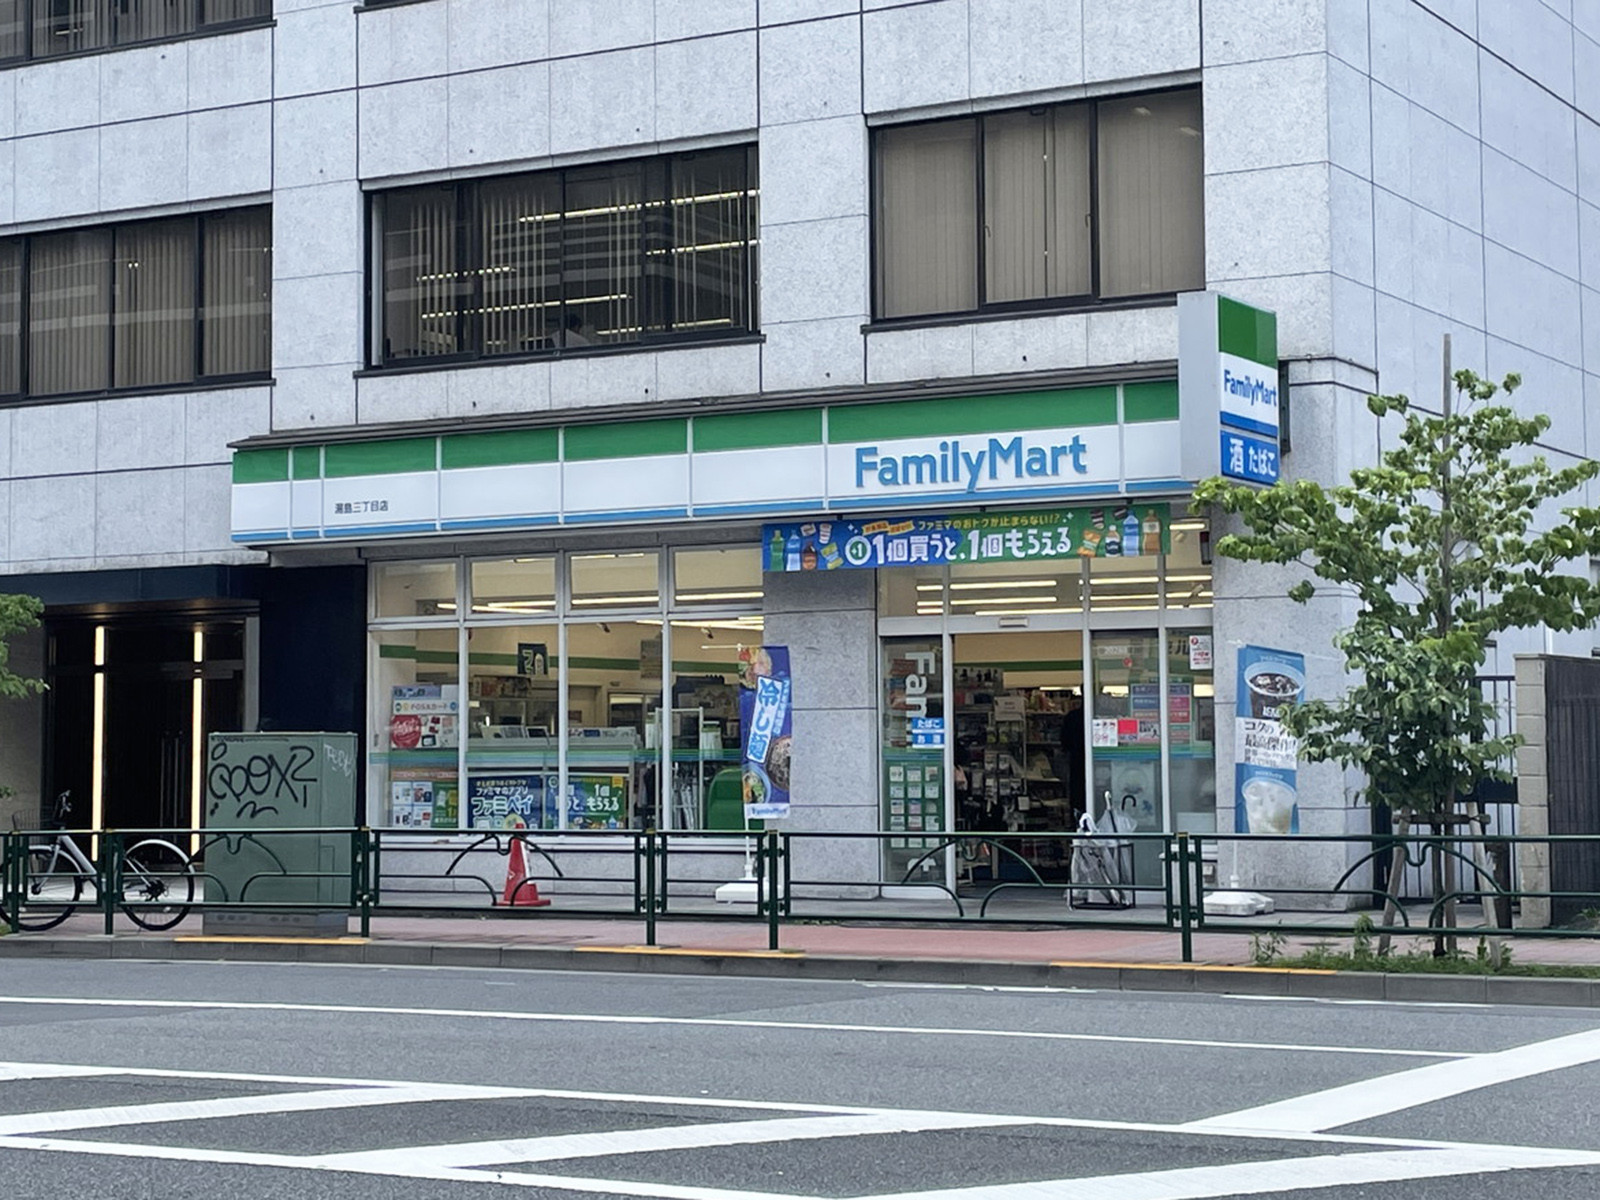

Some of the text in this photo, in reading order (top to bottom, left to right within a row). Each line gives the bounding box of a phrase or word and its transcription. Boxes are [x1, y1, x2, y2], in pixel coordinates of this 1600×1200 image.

[1224, 369, 1277, 407] FamilyMart
[855, 434, 1087, 494] FamilyMart
[1229, 437, 1277, 477] 酒 たばこ
[917, 718, 941, 729] たばこ
[470, 794, 534, 816] ファミペイ
[586, 796, 620, 812] もらえる
